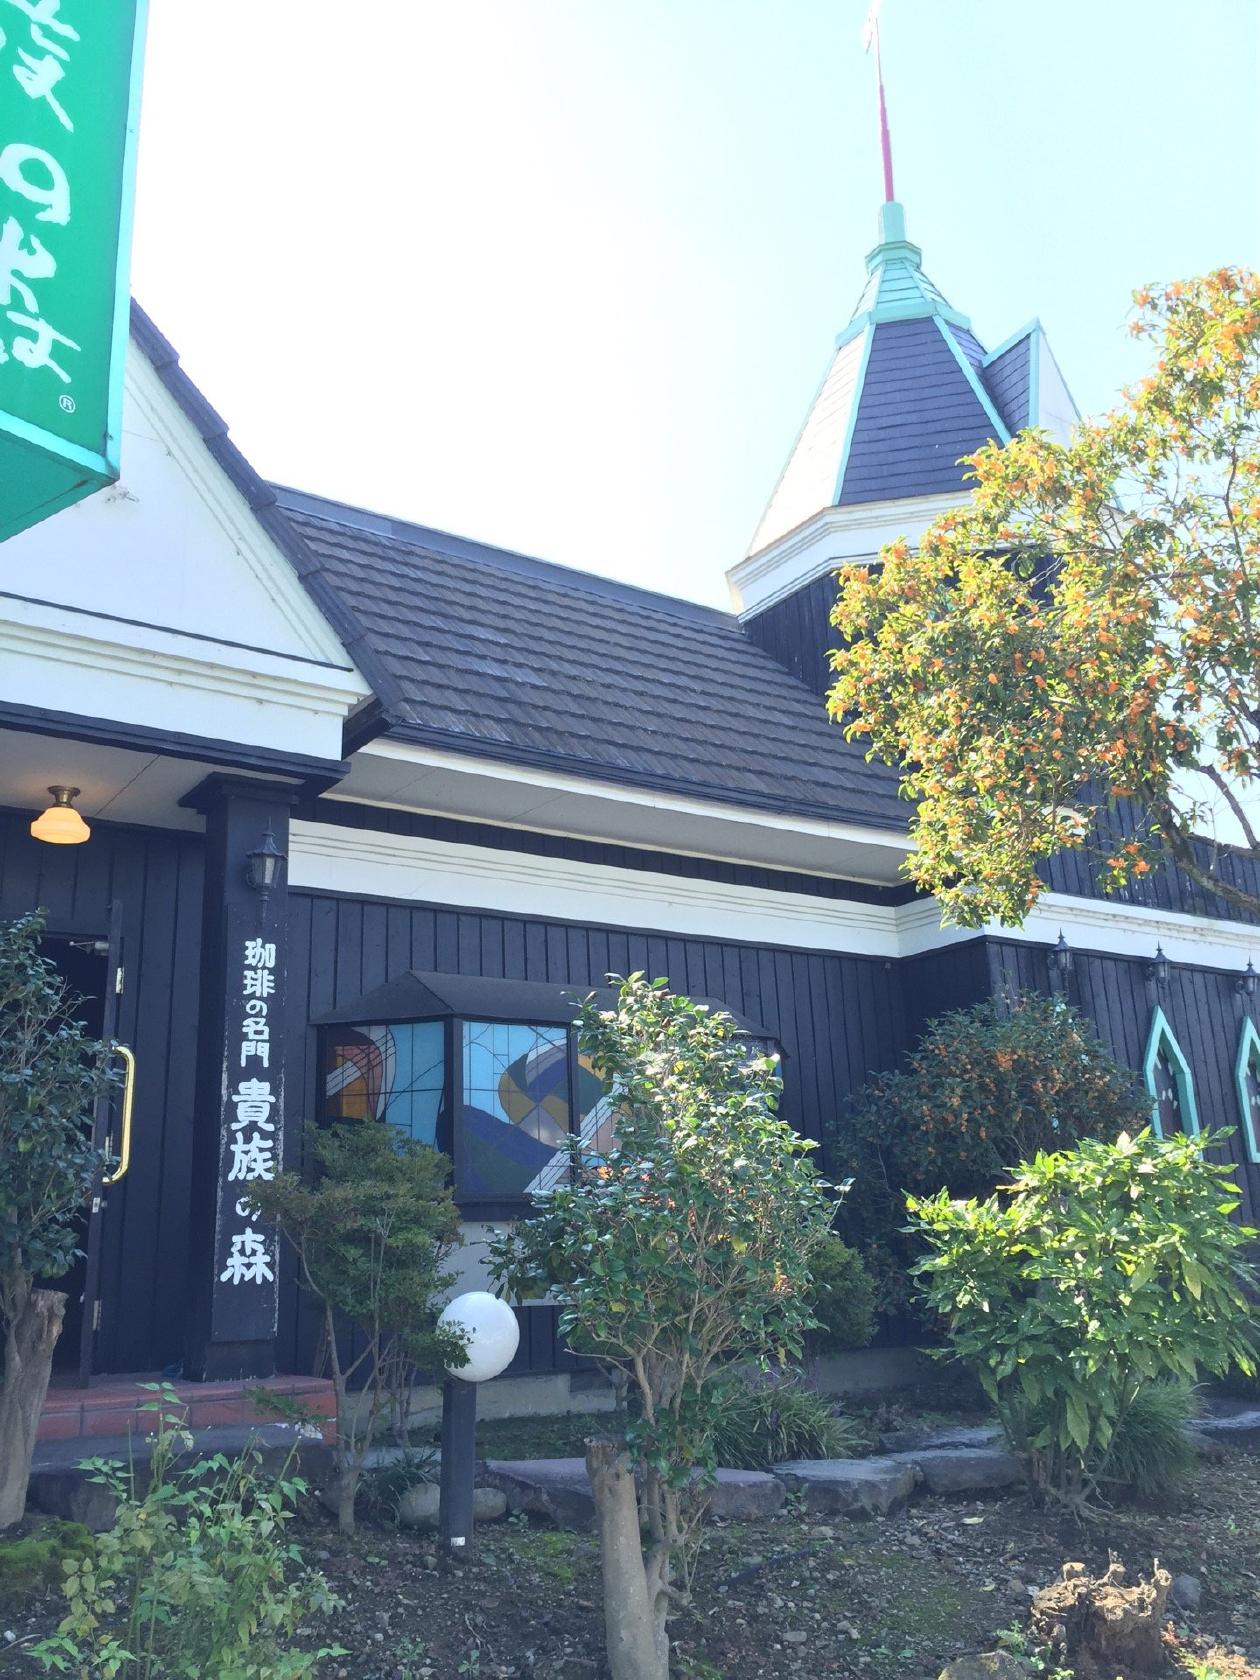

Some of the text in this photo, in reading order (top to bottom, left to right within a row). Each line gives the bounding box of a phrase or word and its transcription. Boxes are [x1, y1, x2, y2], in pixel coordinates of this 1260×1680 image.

[240, 938, 276, 1068] 珈琲の名門
